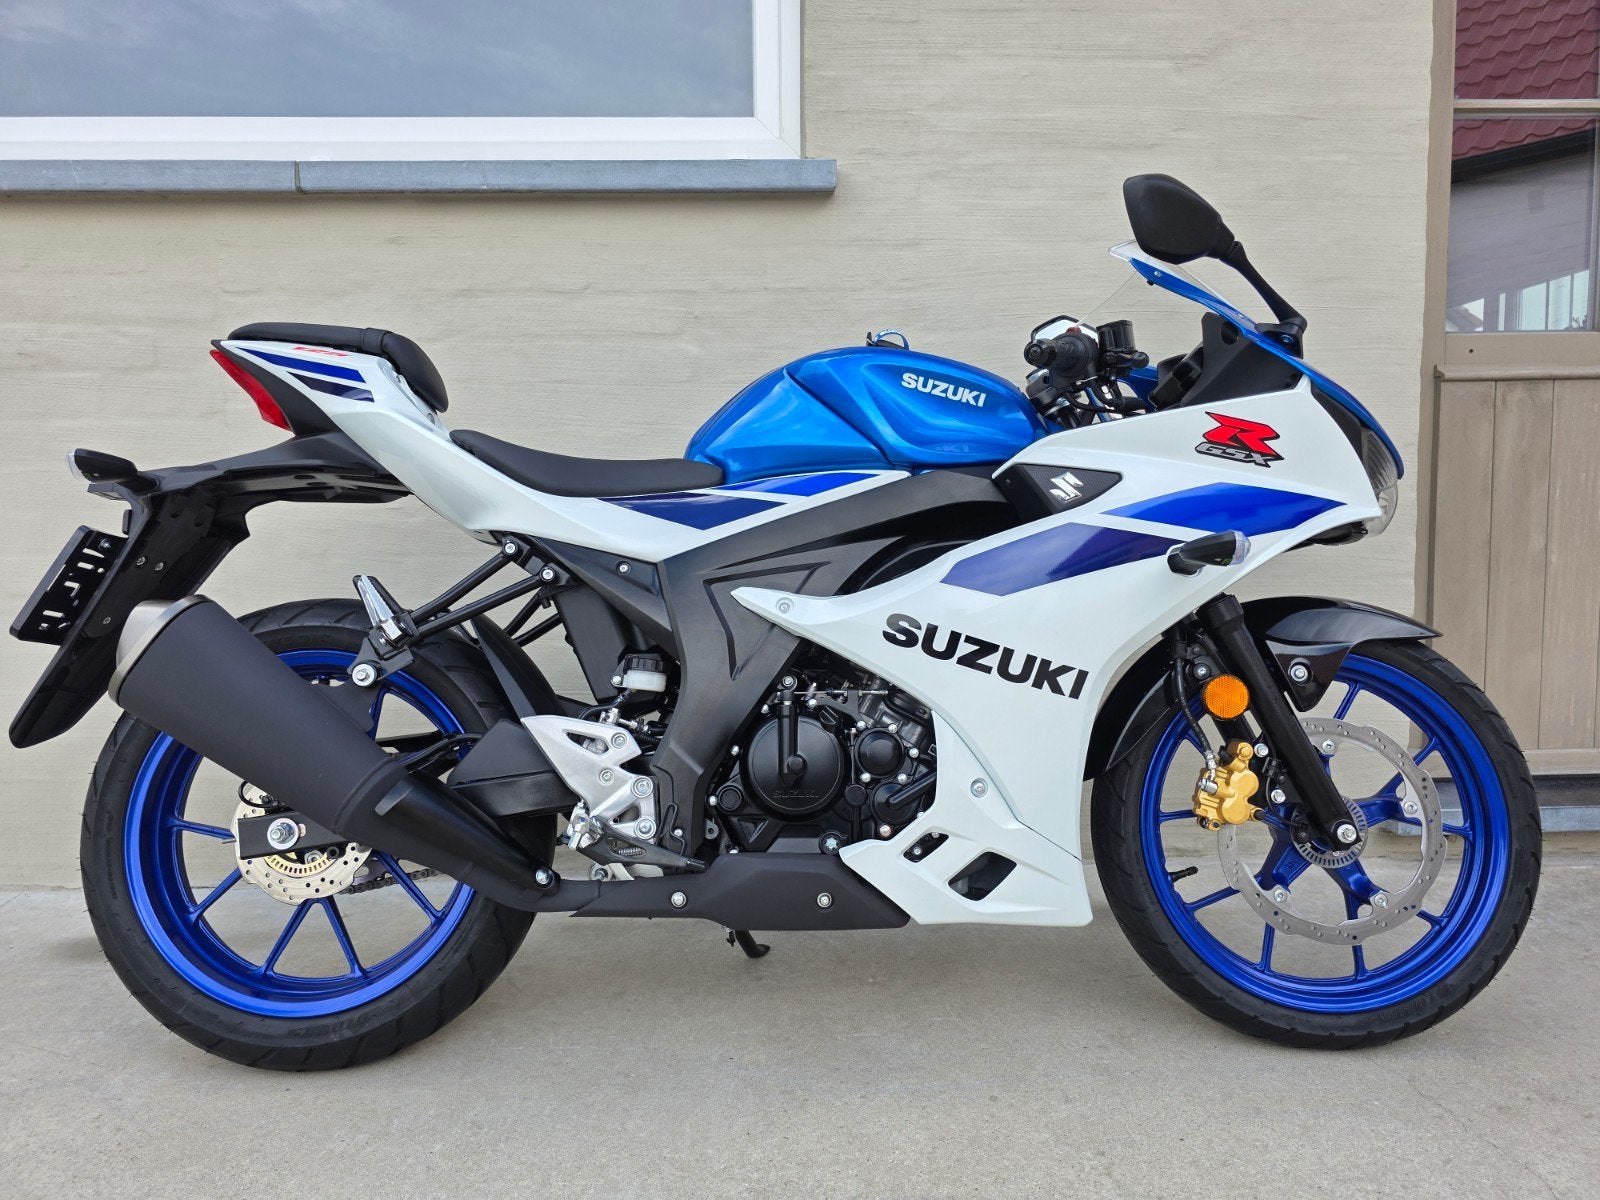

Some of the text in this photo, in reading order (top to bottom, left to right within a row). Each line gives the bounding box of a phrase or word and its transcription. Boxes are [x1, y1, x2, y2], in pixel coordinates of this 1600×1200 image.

[901, 372, 986, 407] SUZUKI
[1194, 441, 1280, 468] GSX
[1203, 411, 1285, 460] R
[882, 613, 1090, 700] SUZUKI
